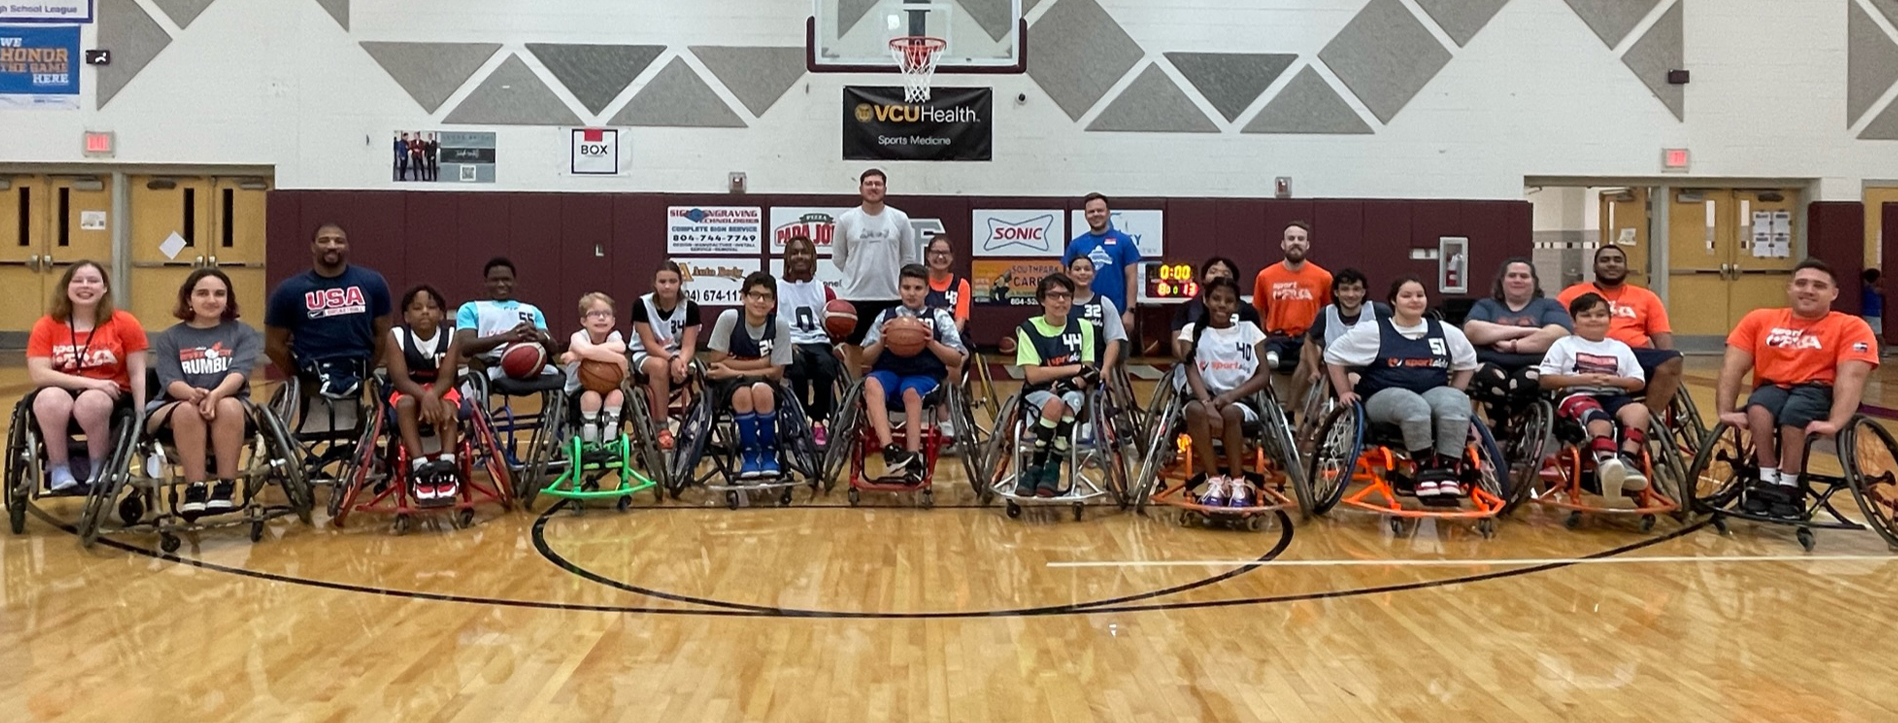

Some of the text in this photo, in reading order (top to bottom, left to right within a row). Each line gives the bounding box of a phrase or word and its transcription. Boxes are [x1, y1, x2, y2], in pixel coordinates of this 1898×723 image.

[10, 5, 42, 13] School
[45, 6, 77, 15] League
[0, 37, 22, 47] WE
[0, 48, 68, 63] HONOR
[33, 74, 69, 84] HERE
[878, 135, 951, 146] Sports Medicine
[581, 144, 608, 155] BOX
[673, 234, 756, 242] 804-744-7749
[993, 227, 1043, 240] SONIC
[1160, 265, 1191, 280] 0:00
[305, 286, 366, 310] USA
[1084, 304, 1101, 317] 32
[1062, 333, 1082, 351] 44
[1428, 338, 1446, 356] 51
[1236, 342, 1252, 361] 40
